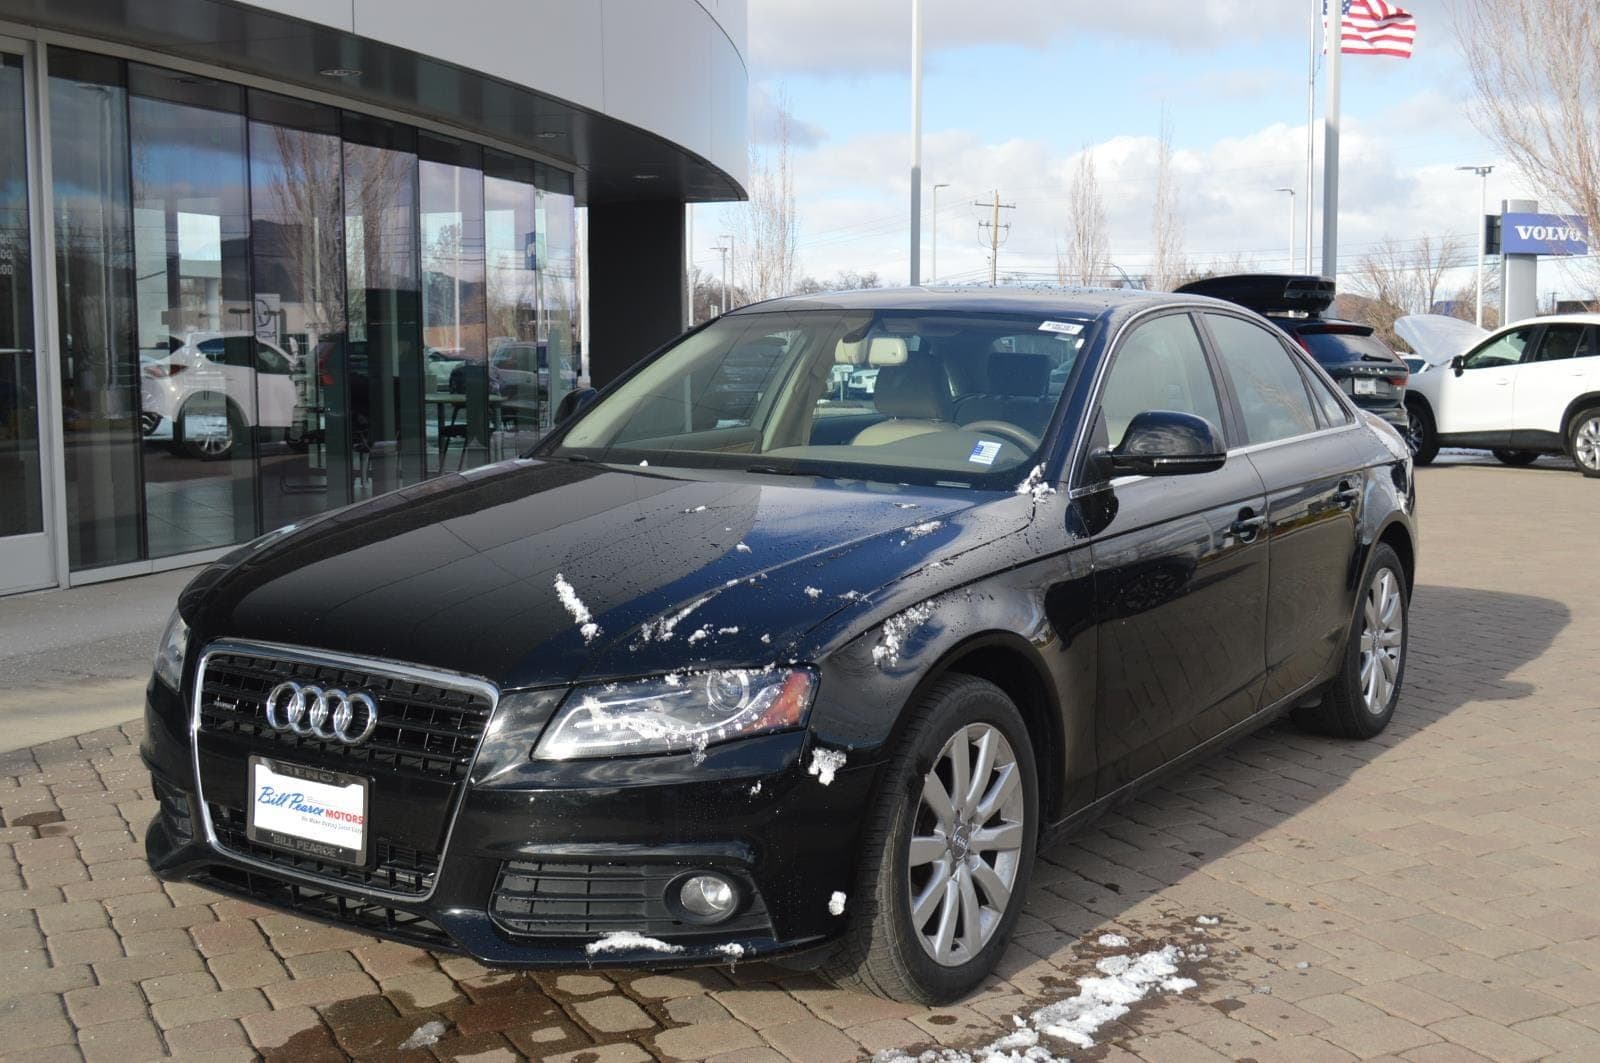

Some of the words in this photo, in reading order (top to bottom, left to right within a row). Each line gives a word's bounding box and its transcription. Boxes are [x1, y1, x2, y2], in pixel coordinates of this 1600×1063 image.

[1515, 225, 1580, 241] VOLVO
[281, 764, 334, 782] RENO
[258, 786, 289, 807] Bill
[288, 793, 325, 816] Pearce
[325, 808, 367, 825] MOTORS
[273, 834, 294, 848] BILL
[296, 839, 337, 857] PEARCE
